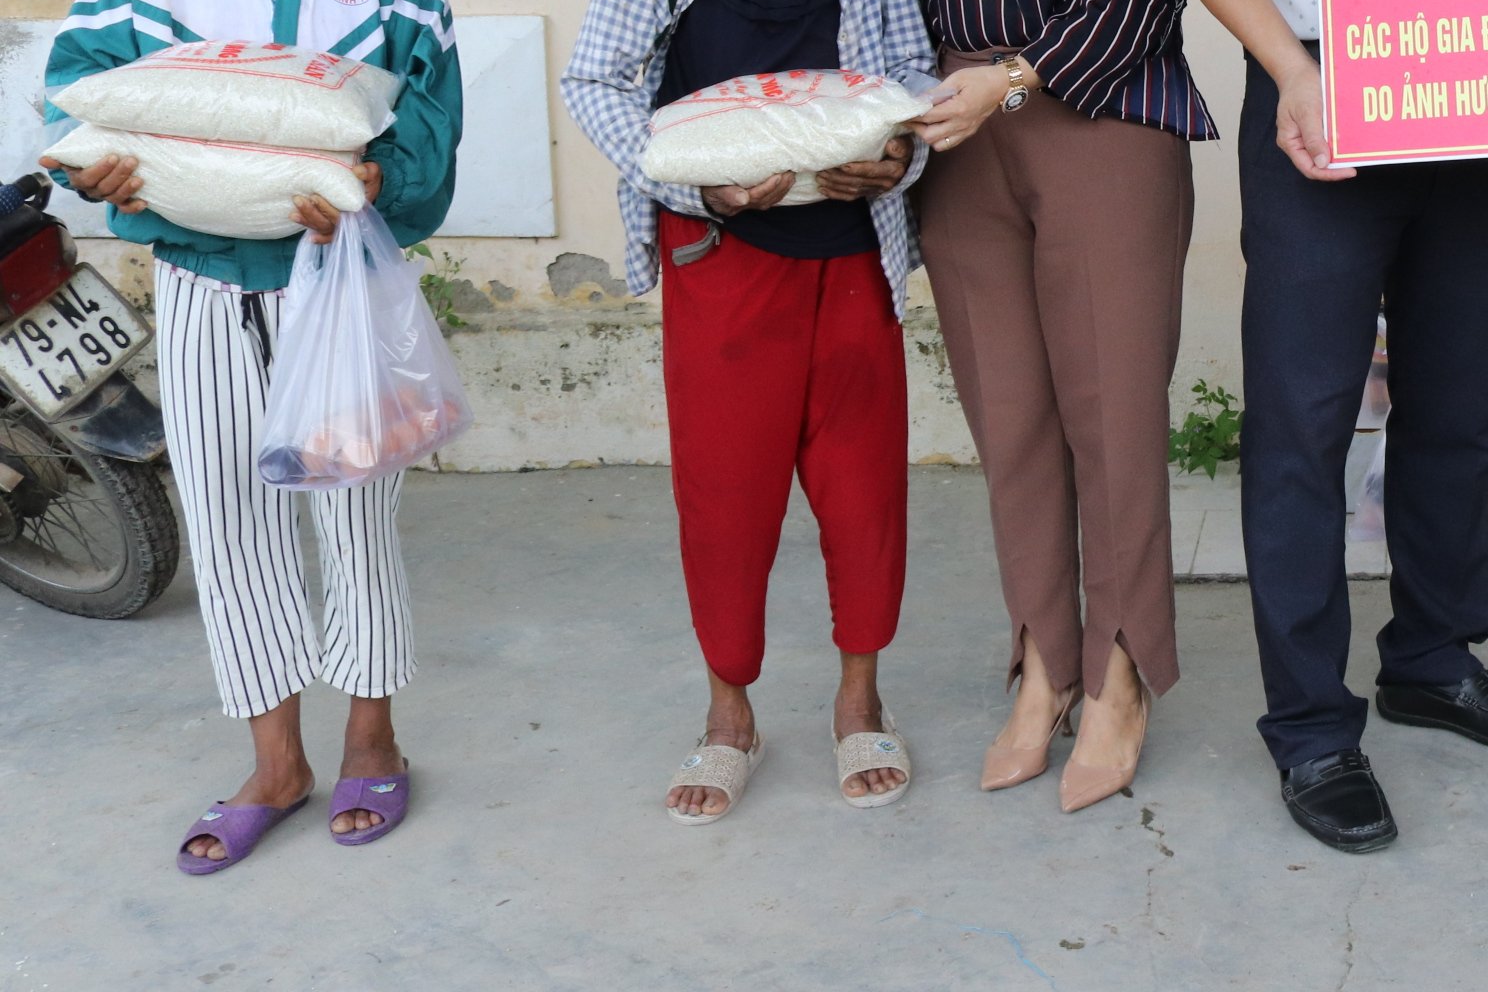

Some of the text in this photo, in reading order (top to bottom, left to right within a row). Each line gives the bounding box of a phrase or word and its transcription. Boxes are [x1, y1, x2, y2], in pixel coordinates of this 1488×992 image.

[1346, 16, 1392, 60] CÁC
[1398, 12, 1430, 63] HỘ
[1436, 16, 1476, 54] GIA
[1362, 85, 1394, 122] DO
[1400, 70, 1449, 120] ẢNH
